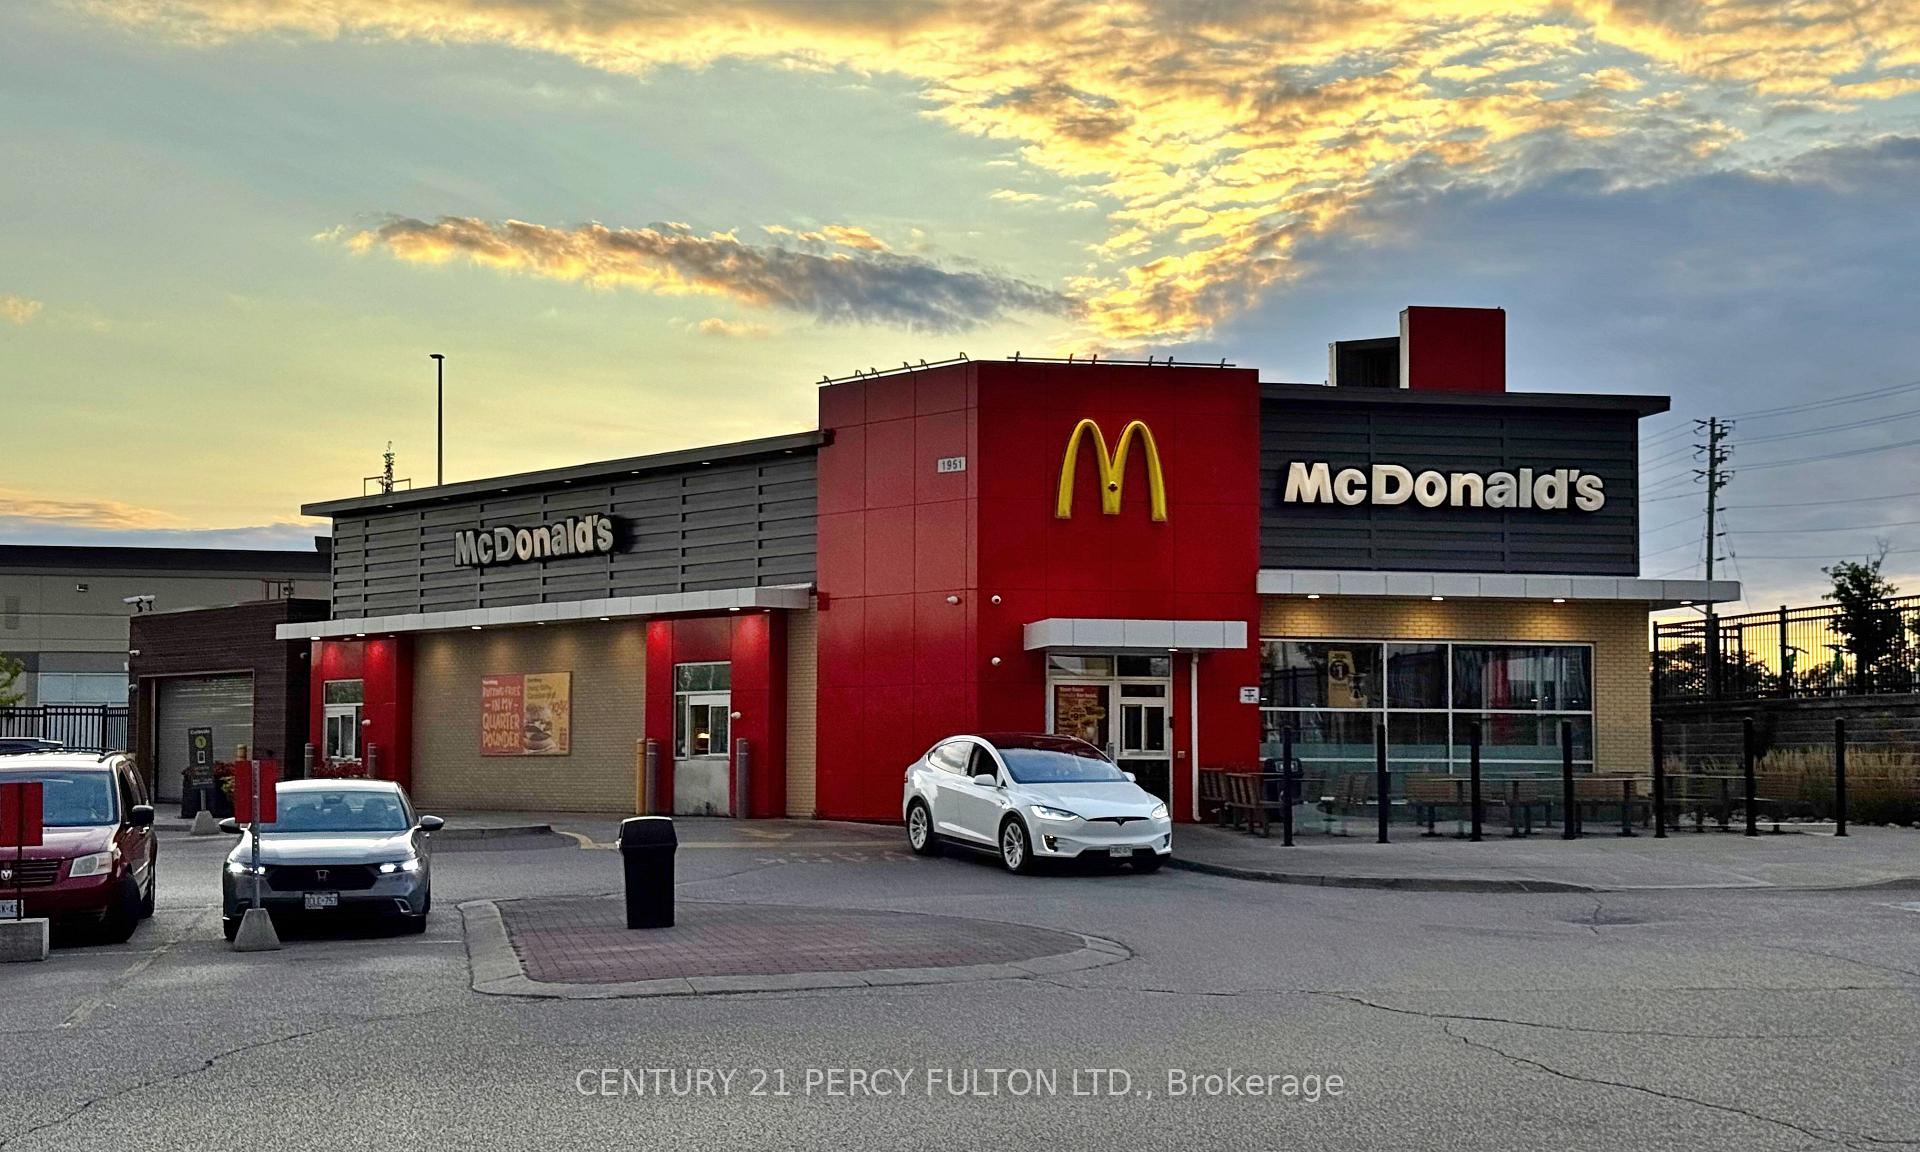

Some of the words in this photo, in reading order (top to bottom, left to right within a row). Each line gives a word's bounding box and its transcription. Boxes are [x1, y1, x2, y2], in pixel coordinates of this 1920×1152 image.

[941, 459, 962, 471] 1951
[1283, 461, 1605, 512] McDonald's
[454, 513, 615, 567] McDonald's
[491, 698, 501, 712] IN
[501, 697, 513, 712] MY
[482, 712, 520, 731] QUARTER
[482, 730, 520, 748] POUNDER
